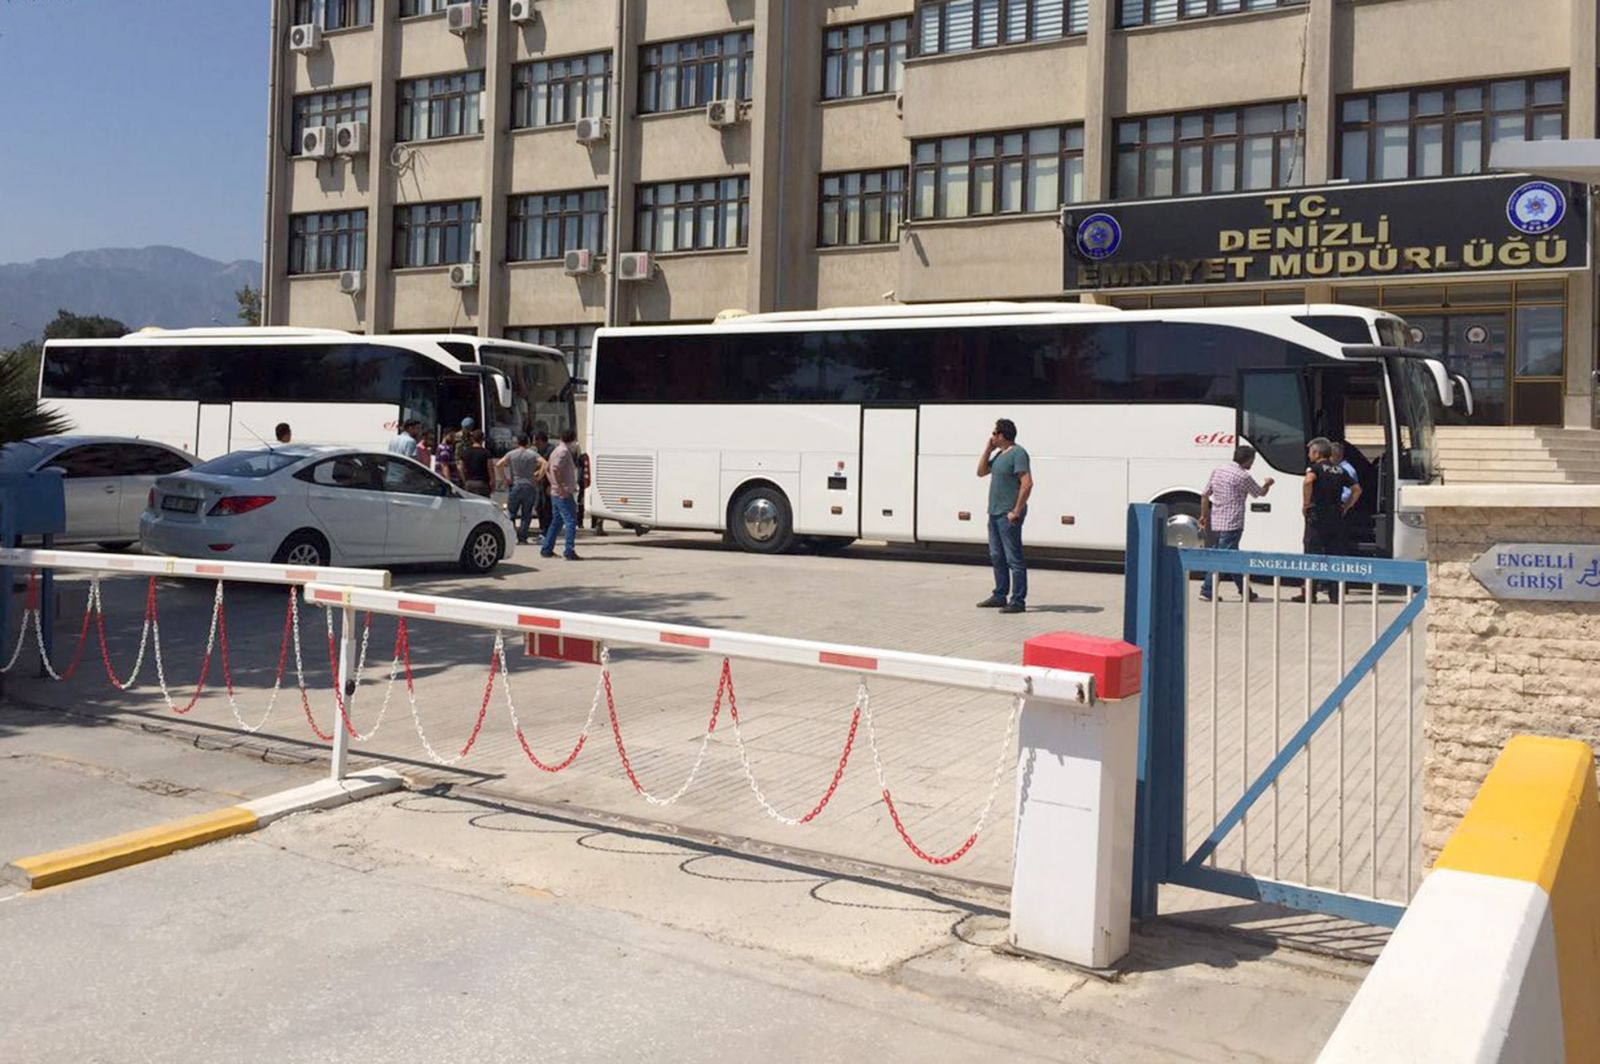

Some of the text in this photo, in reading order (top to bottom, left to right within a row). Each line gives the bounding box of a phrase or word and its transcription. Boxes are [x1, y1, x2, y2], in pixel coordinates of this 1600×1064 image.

[1265, 195, 1340, 220] T.C.
[1219, 214, 1389, 251] DENİZLİ
[1249, 558, 1372, 575] ENGELLİLER GİRİŞİ
[1497, 552, 1574, 569] ENGELLİ
[1507, 571, 1563, 592] GİRİŞİ
